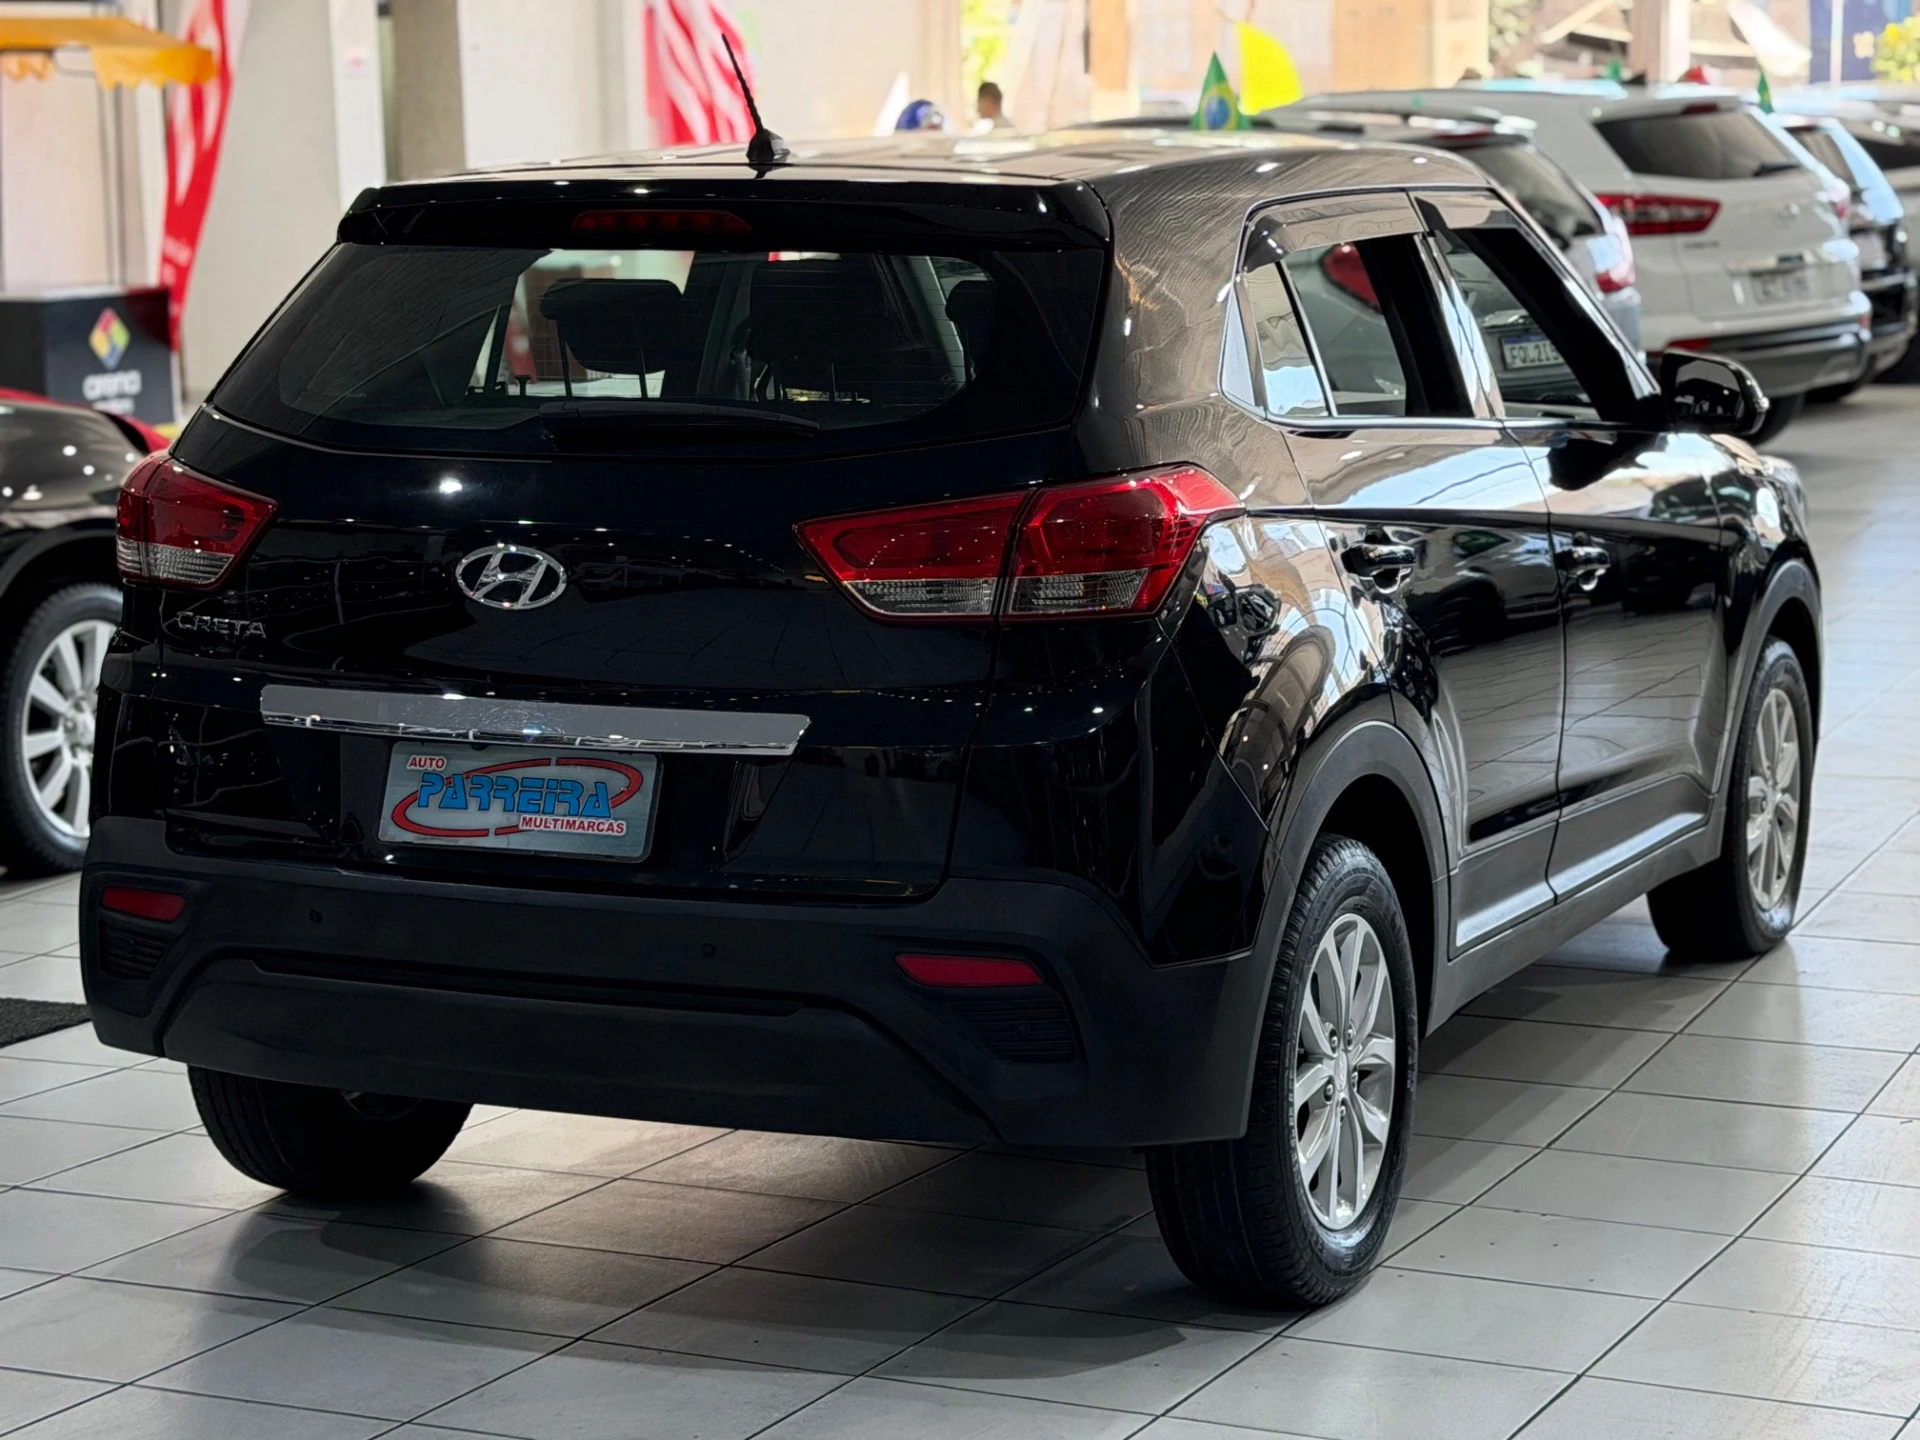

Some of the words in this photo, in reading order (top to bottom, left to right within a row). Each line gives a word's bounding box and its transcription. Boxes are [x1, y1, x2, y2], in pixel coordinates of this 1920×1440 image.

[177, 611, 267, 639] CRETA
[407, 755, 445, 769] AUTO
[417, 772, 612, 818] PARREIRA
[521, 816, 625, 834] MULTIMARCAS
